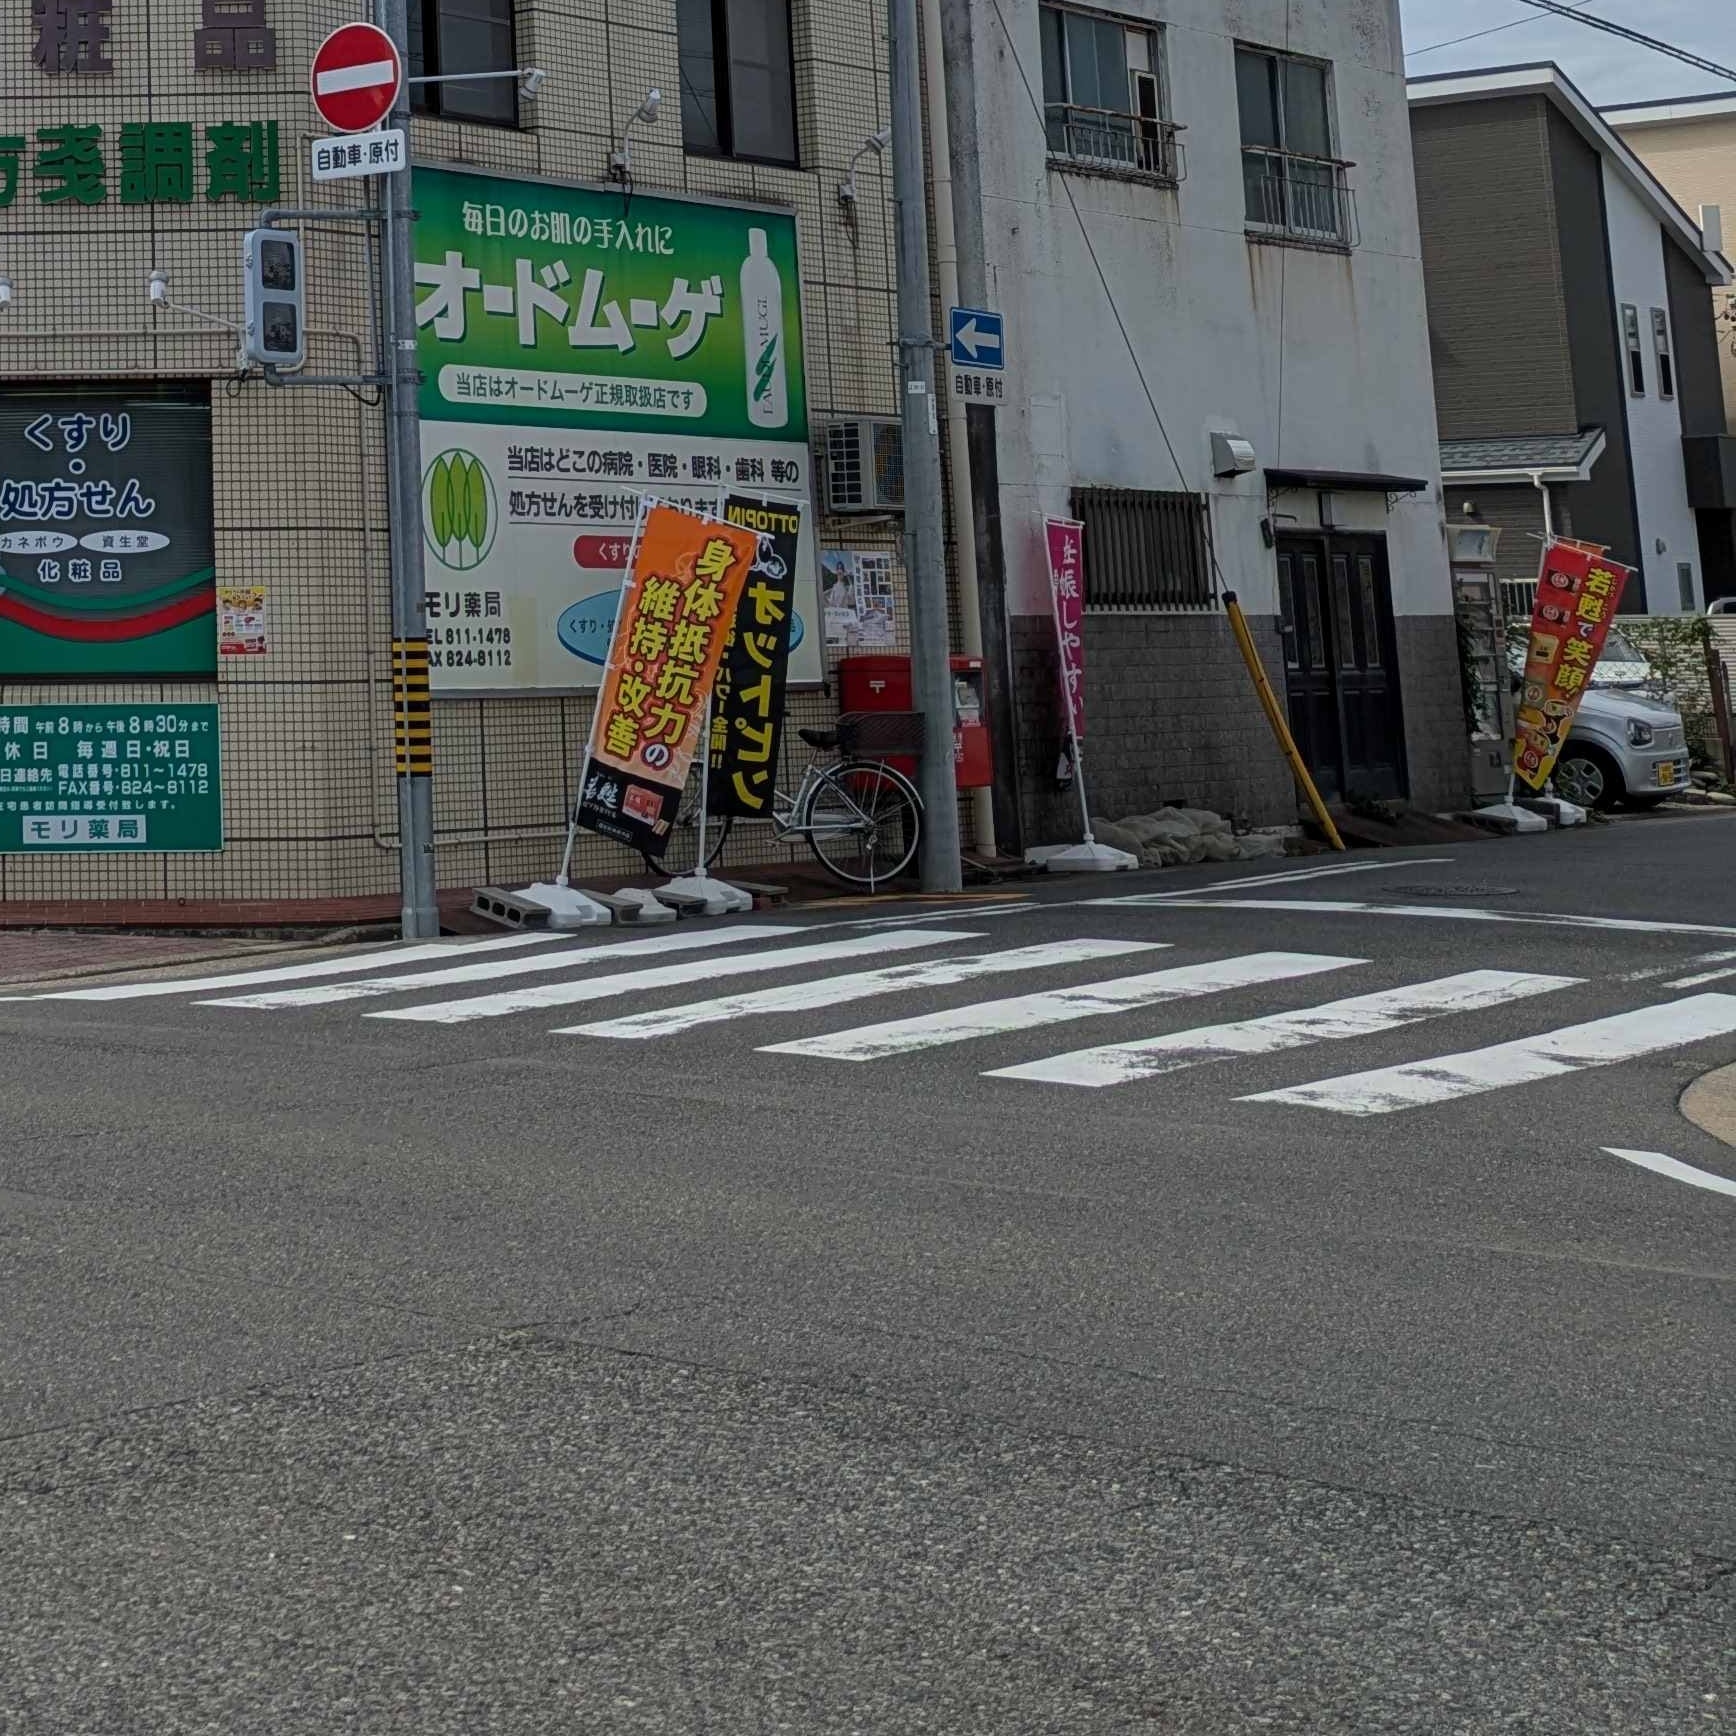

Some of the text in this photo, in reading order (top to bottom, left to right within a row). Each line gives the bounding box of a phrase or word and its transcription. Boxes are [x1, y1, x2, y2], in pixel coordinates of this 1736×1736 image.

[317, 139, 400, 171] 自動車・原付
[462, 201, 675, 256] 毎日のお肌の手入れに
[414, 250, 725, 359] オードムーゲ
[456, 372, 694, 411] 当店はオードムーゲ正規取扱店です
[24, 412, 131, 452] くすり
[0, 478, 156, 520] 処方せん
[0, 535, 65, 549] カネボウ
[102, 534, 150, 549] 資生堂
[37, 559, 122, 582] 化粧品
[424, 591, 502, 618] モリ薬局
[426, 628, 443, 645] EL
[427, 650, 443, 668] AX
[603, 576, 681, 759] 維持・改善
[640, 538, 736, 770] 身体抵抗力の
[76, 740, 191, 760] 毎週日・祝日
[30, 819, 140, 840] モリ薬局
